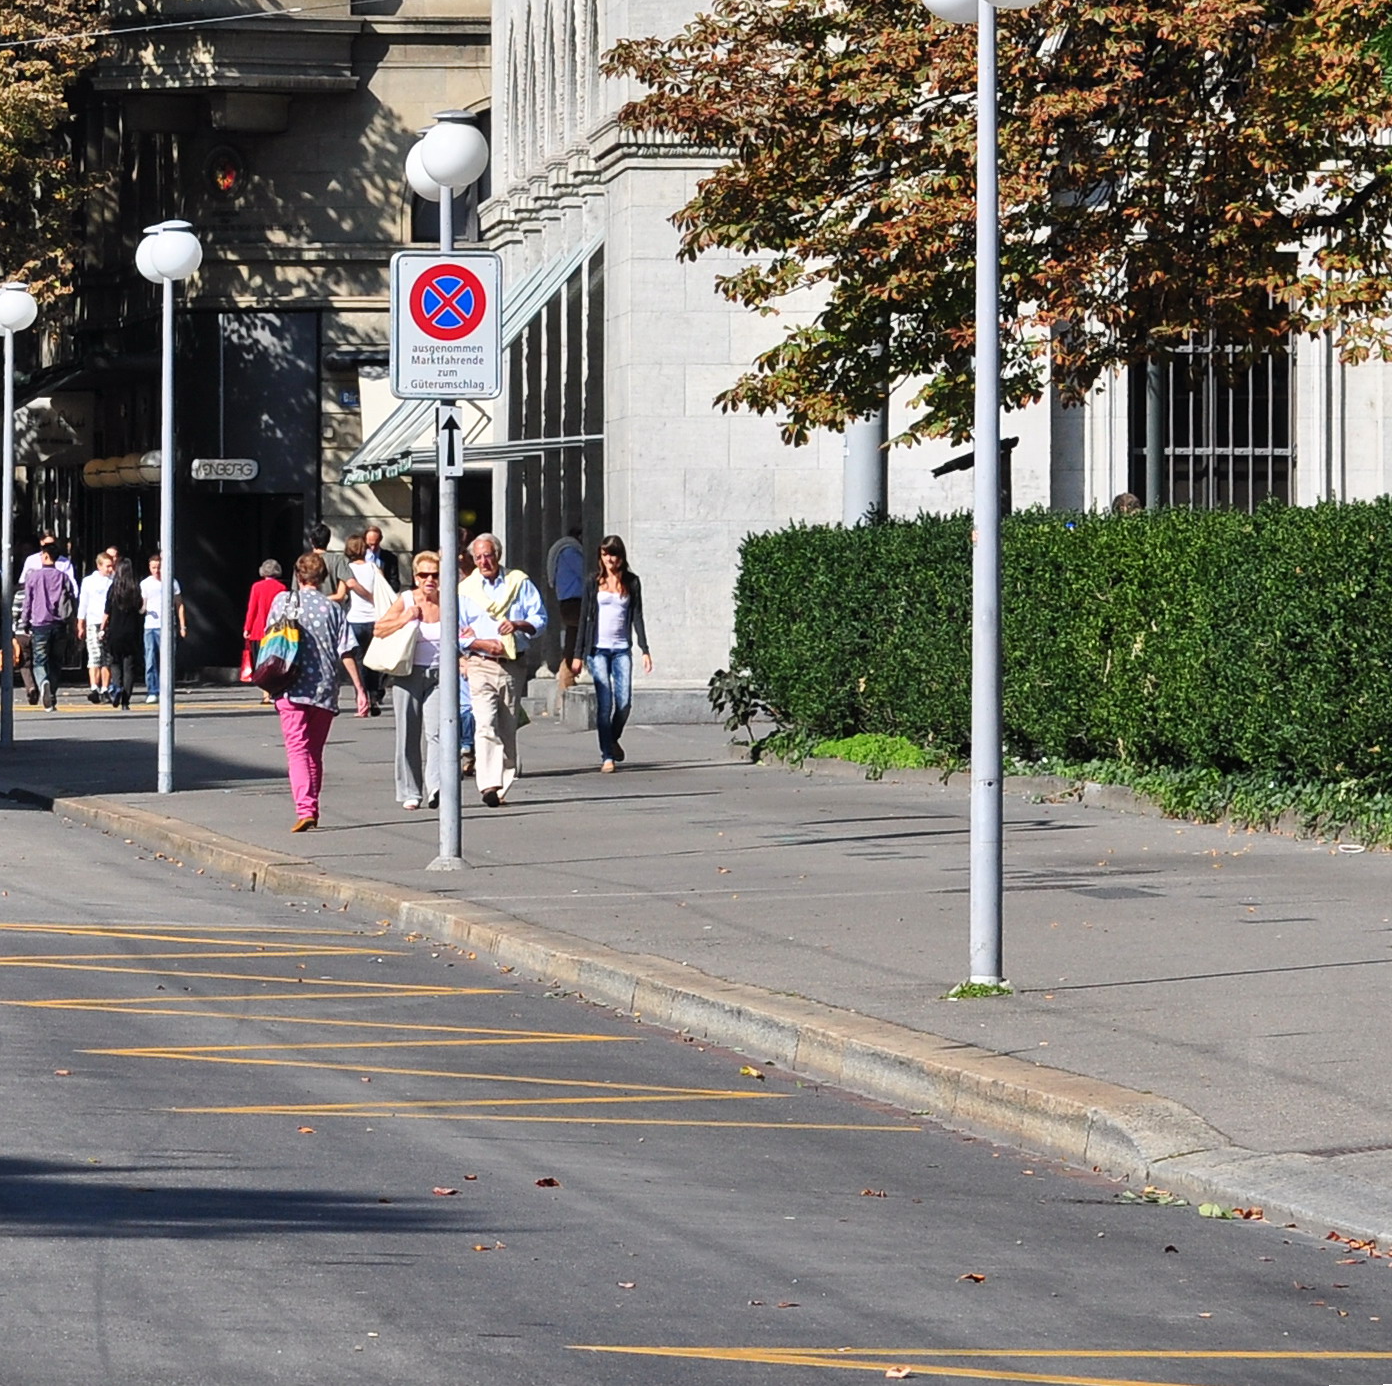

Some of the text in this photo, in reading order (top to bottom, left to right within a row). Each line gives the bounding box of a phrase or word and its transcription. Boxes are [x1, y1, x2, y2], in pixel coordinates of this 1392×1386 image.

[412, 345, 484, 355] ausgenommen
[411, 355, 485, 365] Marktfahrende
[437, 369, 458, 377] zum
[411, 378, 485, 391] Güterumschlag
